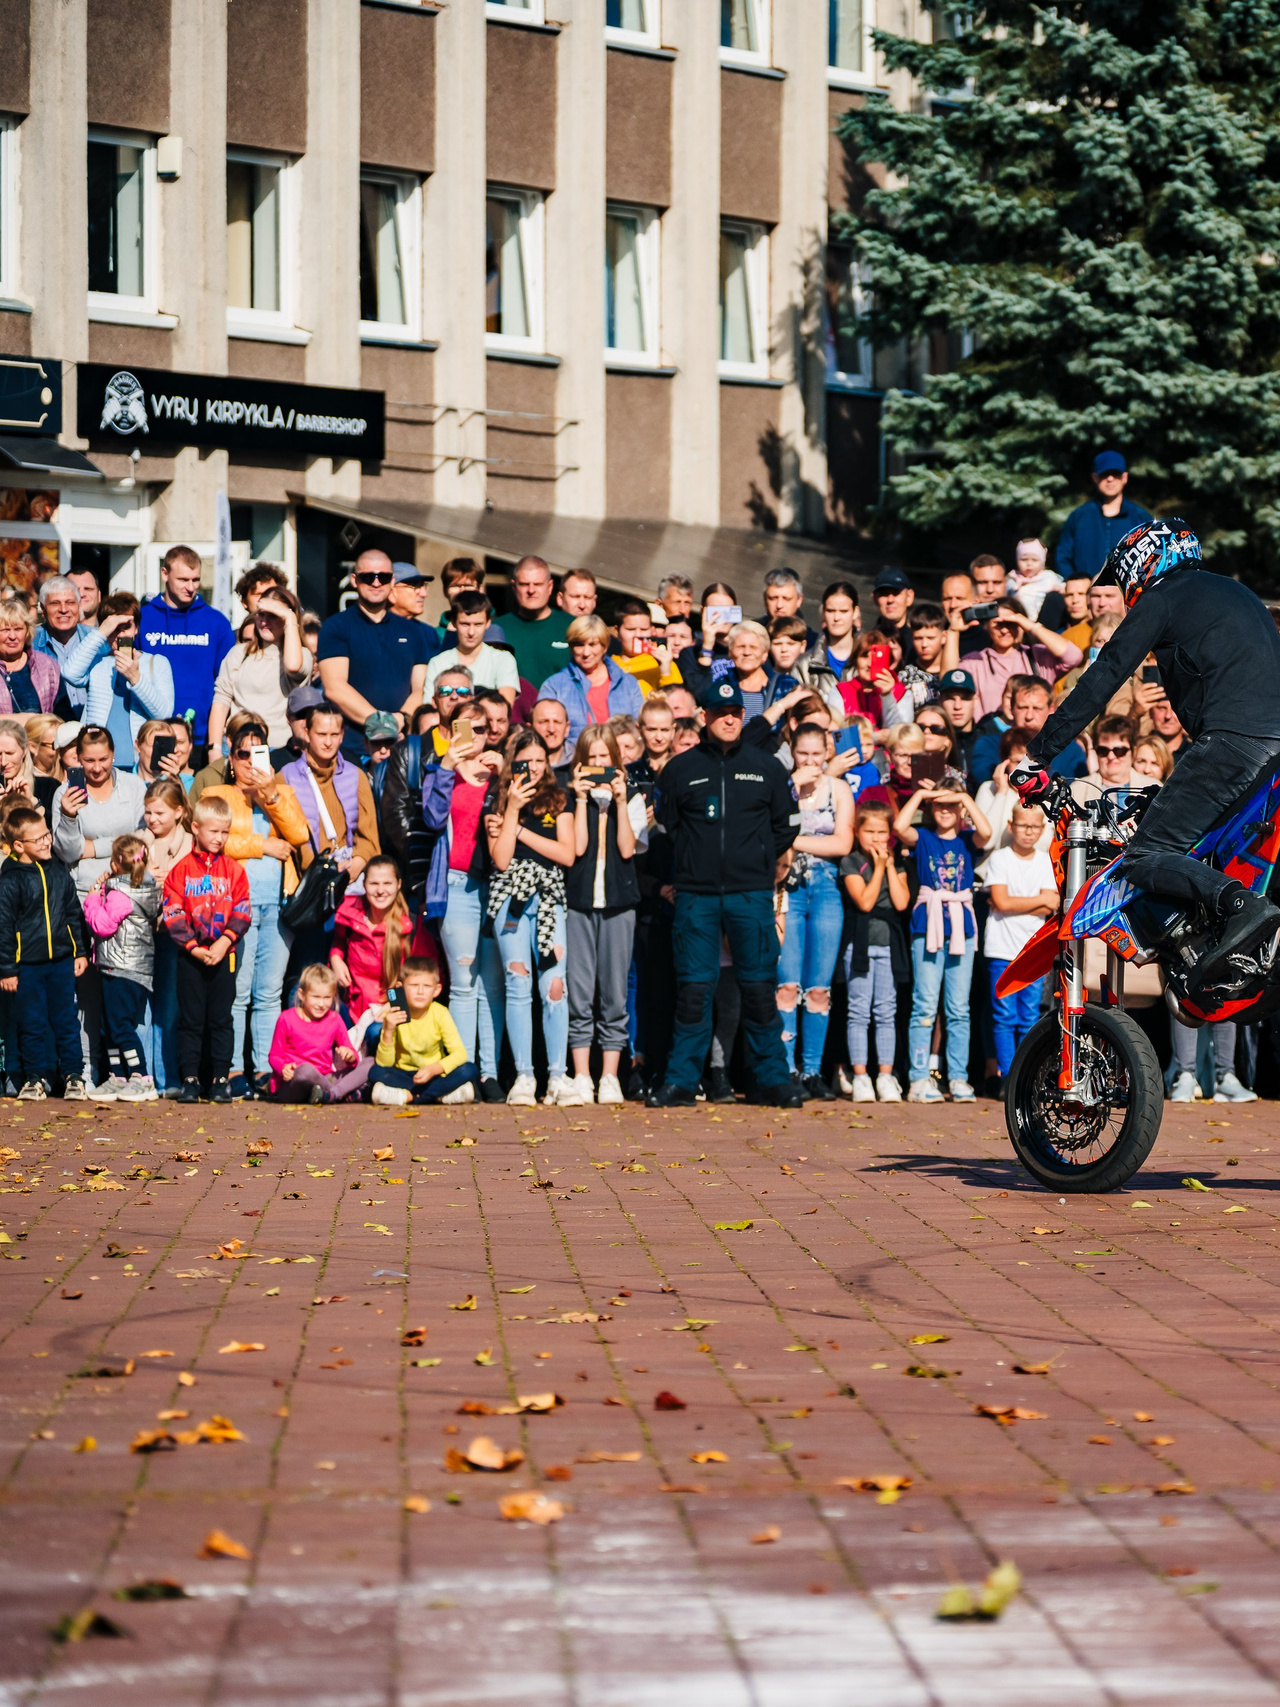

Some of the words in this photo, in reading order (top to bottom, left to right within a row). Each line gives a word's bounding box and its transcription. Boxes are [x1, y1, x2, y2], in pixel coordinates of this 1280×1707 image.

[151, 394, 199, 426] VYRŲ
[296, 413, 367, 436] BARBERSHOP
[161, 632, 209, 646] hummel
[734, 773, 764, 782] POLICIJA
